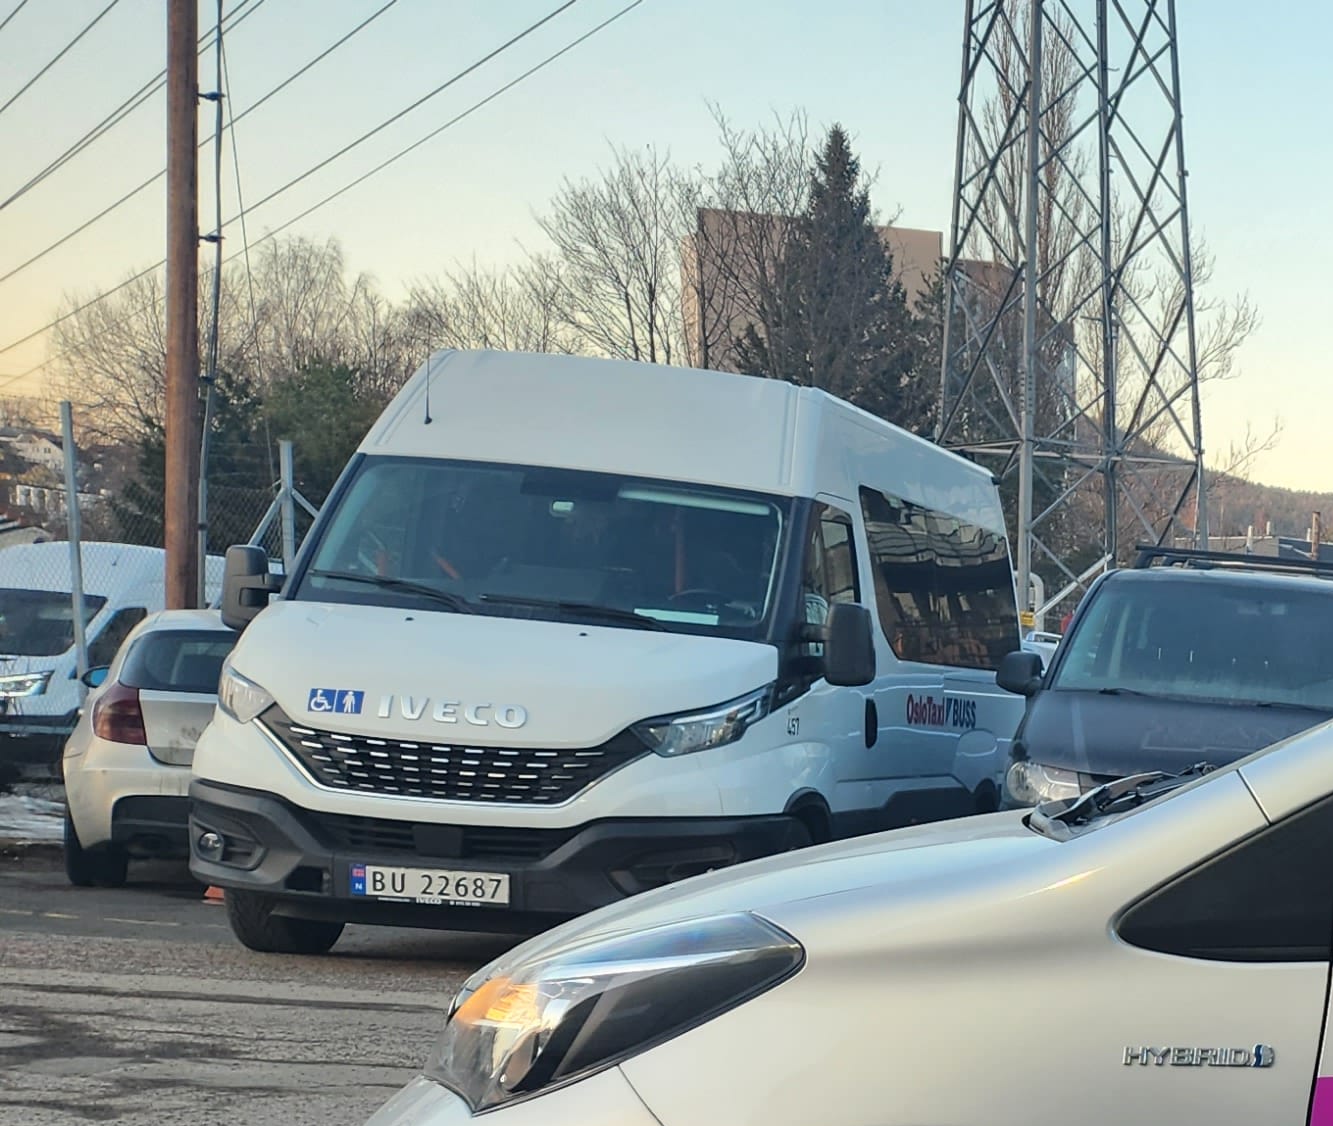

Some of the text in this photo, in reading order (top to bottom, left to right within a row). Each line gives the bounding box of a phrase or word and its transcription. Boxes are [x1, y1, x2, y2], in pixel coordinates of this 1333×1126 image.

[377, 695, 528, 729] IVECO
[907, 694, 976, 728] OsloTaxi BUSS
[787, 717, 799, 736] 457
[372, 871, 502, 899] BU 22687
[1123, 1046, 1249, 1066] HYBRID
